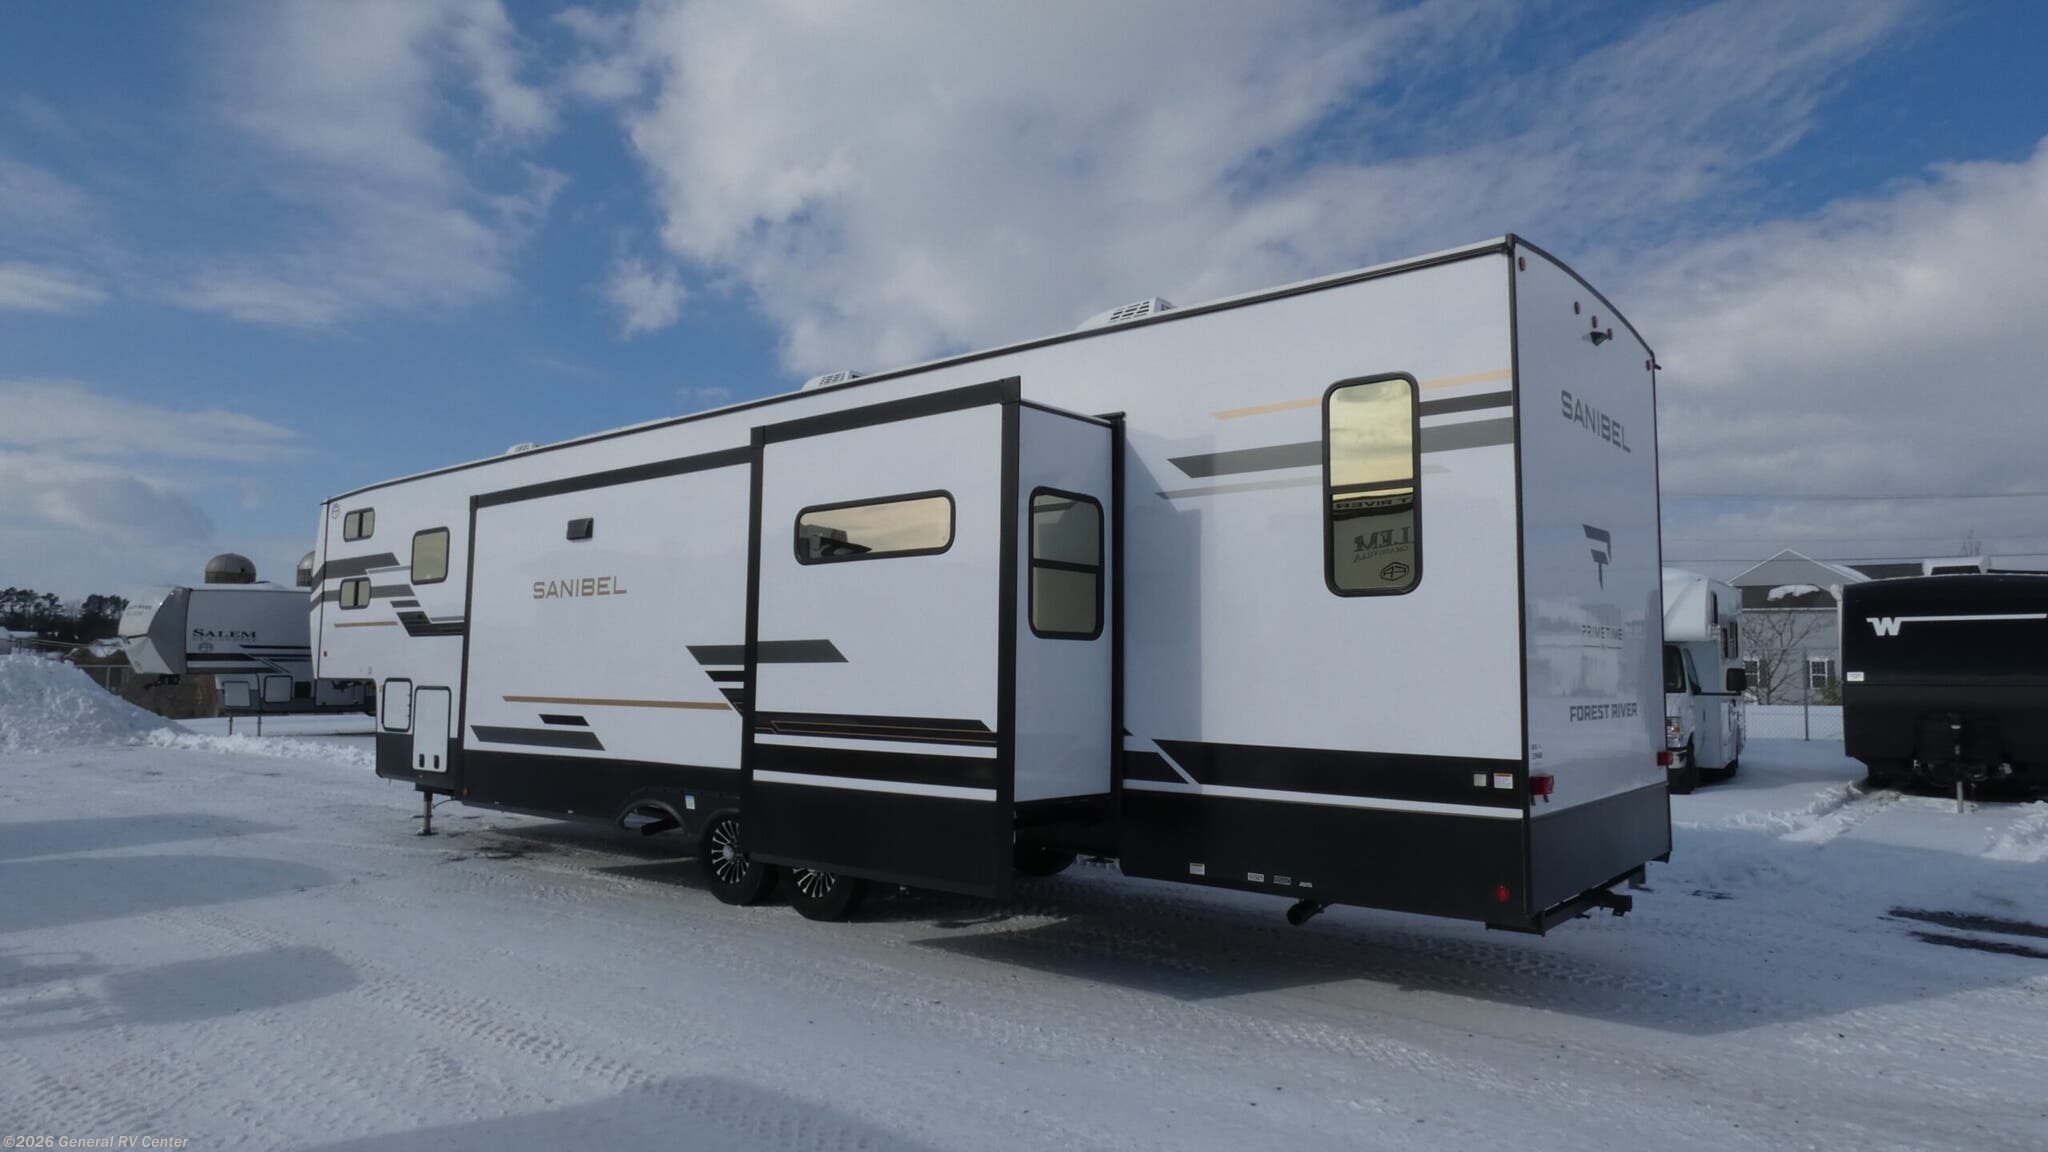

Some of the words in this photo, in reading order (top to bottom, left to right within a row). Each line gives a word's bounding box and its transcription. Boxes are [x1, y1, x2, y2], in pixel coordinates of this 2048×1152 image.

[1561, 389, 1631, 453] SANIBEL
[533, 576, 627, 599] SANIBEL
[192, 628, 257, 638] SALEM
[1582, 624, 1624, 641] PRIMETIME
[1866, 616, 1902, 636] W
[1569, 704, 1609, 722] FOREST
[1611, 703, 1639, 719] RIVER
